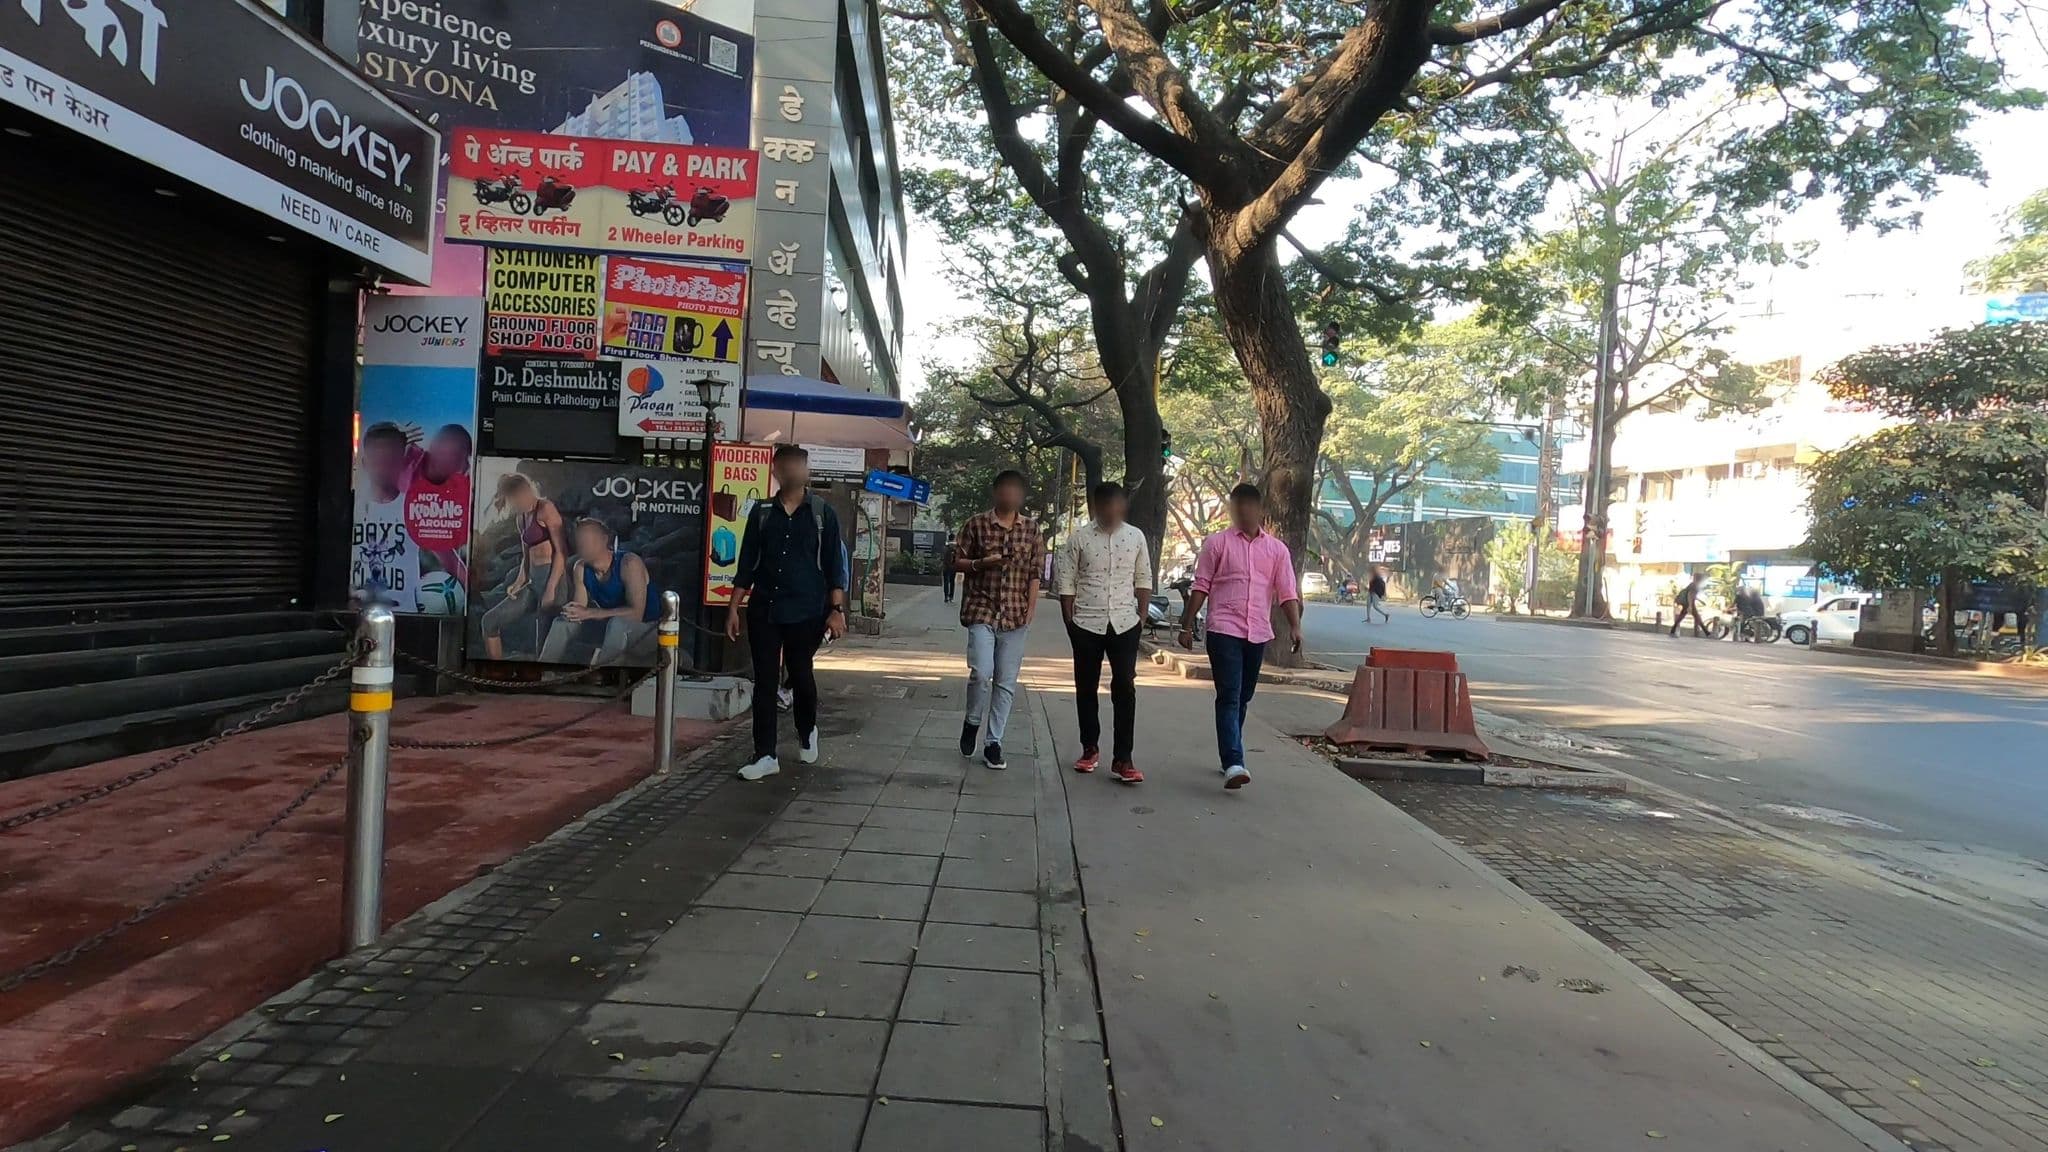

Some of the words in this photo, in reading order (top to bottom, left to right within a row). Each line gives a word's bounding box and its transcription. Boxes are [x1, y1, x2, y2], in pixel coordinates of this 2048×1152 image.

[451, 40, 537, 94] living
[24, 75, 55, 106] एन
[64, 85, 110, 132] केअर
[239, 66, 411, 187] JOCKEY
[464, 134, 481, 163] पे
[539, 142, 584, 170] पार्क
[240, 123, 297, 167] clothing
[300, 155, 353, 193] mankind
[356, 184, 385, 210] since
[388, 200, 413, 224] 1876
[612, 149, 656, 174] PAY
[662, 153, 679, 176] &
[687, 155, 749, 181] PARK
[281, 193, 321, 224] NEED
[345, 224, 381, 253] CARE
[608, 226, 617, 241] 2
[622, 227, 683, 246] Wheeler
[687, 232, 744, 253] Parking
[495, 248, 597, 270] STATIONERY
[494, 269, 596, 293] COMPUTER
[491, 293, 596, 316] ACCESSORIES
[677, 302, 706, 312] PHOTO
[708, 305, 739, 316] STUDIO
[374, 315, 469, 333] JOCKEY
[489, 317, 546, 332] GROUND
[551, 320, 595, 334] FLOOR
[421, 337, 465, 347] JUNIORS
[490, 331, 536, 346] SHOP
[605, 346, 627, 356] First
[494, 366, 516, 386] Dr.
[522, 367, 620, 390] Deshmukh's
[492, 390, 513, 402] Pain
[515, 392, 542, 404] Clinic
[543, 393, 551, 405] &
[554, 393, 601, 409] Pathology
[715, 448, 769, 464] MODERN
[724, 466, 757, 481] BAGS
[418, 493, 439, 502] NOT
[592, 477, 703, 500] JOCKEY
[649, 502, 701, 514] NOTHING
[419, 519, 462, 528] AROUND
